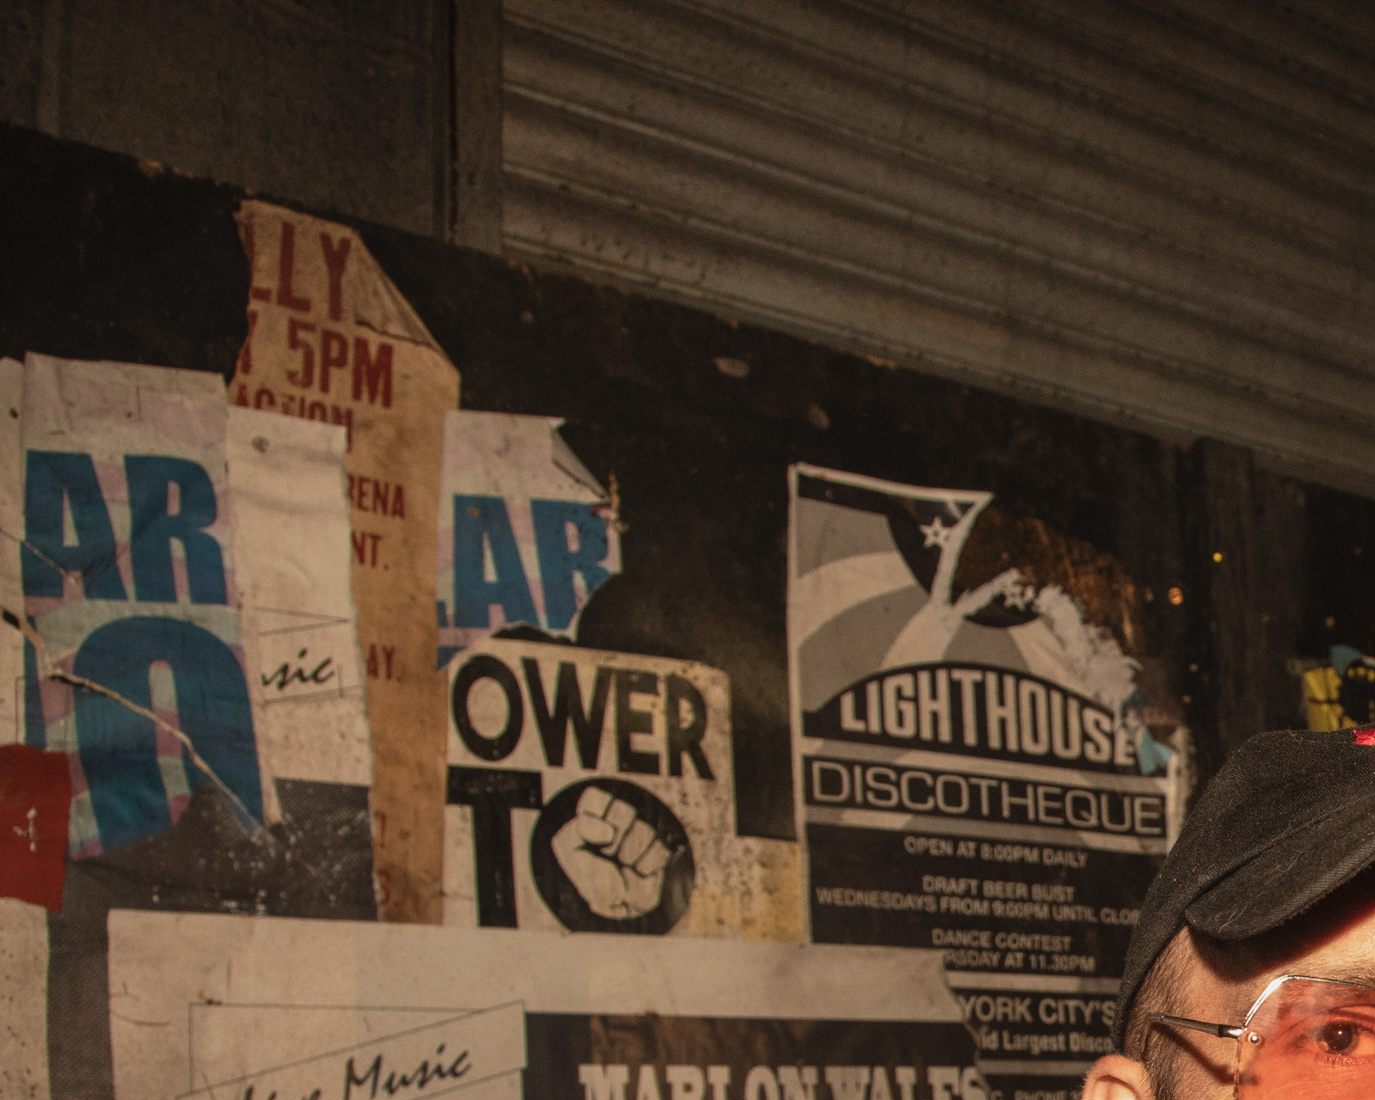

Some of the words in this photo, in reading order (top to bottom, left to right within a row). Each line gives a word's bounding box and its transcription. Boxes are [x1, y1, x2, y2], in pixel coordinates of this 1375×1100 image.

[286, 317, 394, 409] 5PM
[261, 648, 335, 690] sic
[451, 654, 716, 780] OWER
[839, 667, 1137, 766] LIGHTHOUSE
[811, 760, 1162, 835] DISCOTHEQUE
[903, 836, 954, 857] OPEN
[956, 840, 978, 859] AT
[1042, 848, 1089, 868] DAILY
[816, 887, 937, 913] WEDNESDAYS
[940, 896, 991, 917] FROM
[1052, 904, 1098, 924] UNTIL
[922, 875, 980, 896] DRAFT
[983, 880, 1029, 900] BEER
[1031, 884, 1075, 903] BUST
[931, 928, 992, 949] DANCE
[994, 932, 1072, 953] CONTEST
[1003, 952, 1025, 970] AT
[957, 995, 1034, 1024] YORK
[1001, 1029, 1067, 1056] Largest
